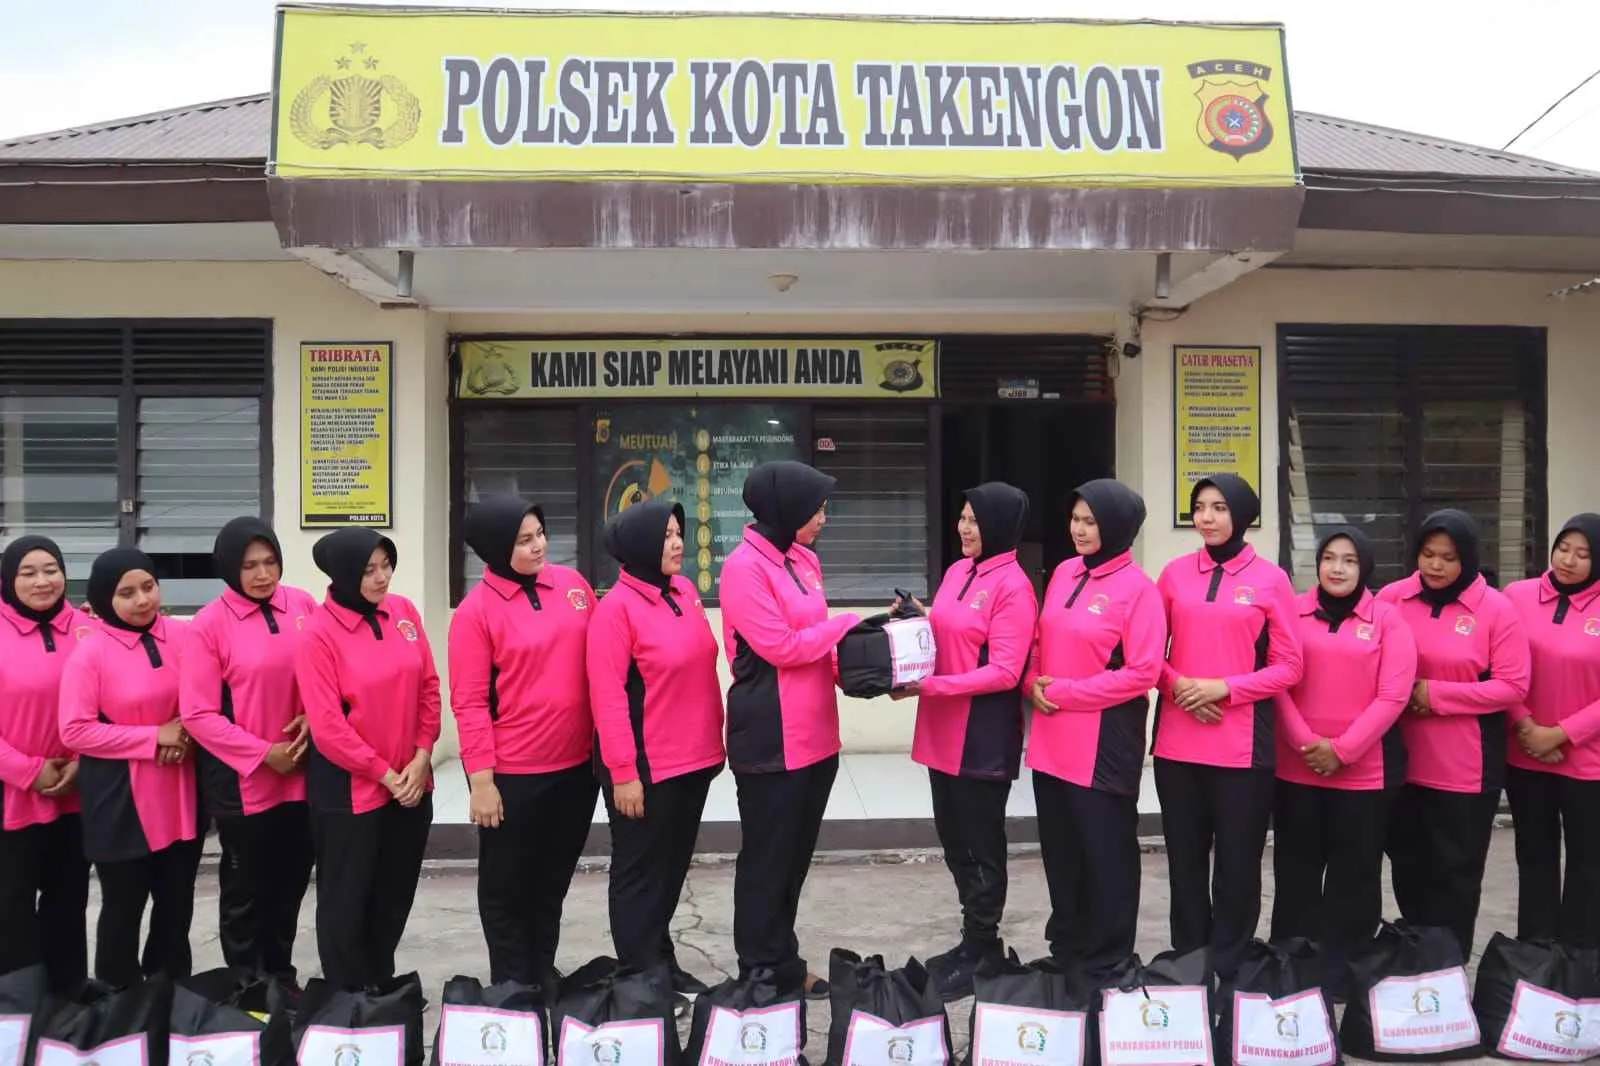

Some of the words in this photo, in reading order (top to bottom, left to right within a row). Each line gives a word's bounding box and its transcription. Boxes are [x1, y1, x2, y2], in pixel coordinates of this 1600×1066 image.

[1196, 63, 1264, 76] ACEH
[441, 57, 675, 146] POLSEK
[689, 60, 845, 147] KOTA
[857, 63, 1164, 151] TAKENGON
[310, 349, 382, 362] TRIBRATA
[1182, 354, 1209, 367] CATUR
[1211, 354, 1254, 368] PRASETYA
[531, 351, 597, 387] KAMI
[603, 351, 662, 387] SIAP
[668, 349, 788, 386] MELAYANI
[794, 349, 863, 385] ANDA
[620, 433, 677, 449] MEUTUAH
[1173, 1039, 1203, 1050] PEDULI
[1305, 1042, 1329, 1056] PEDULI
